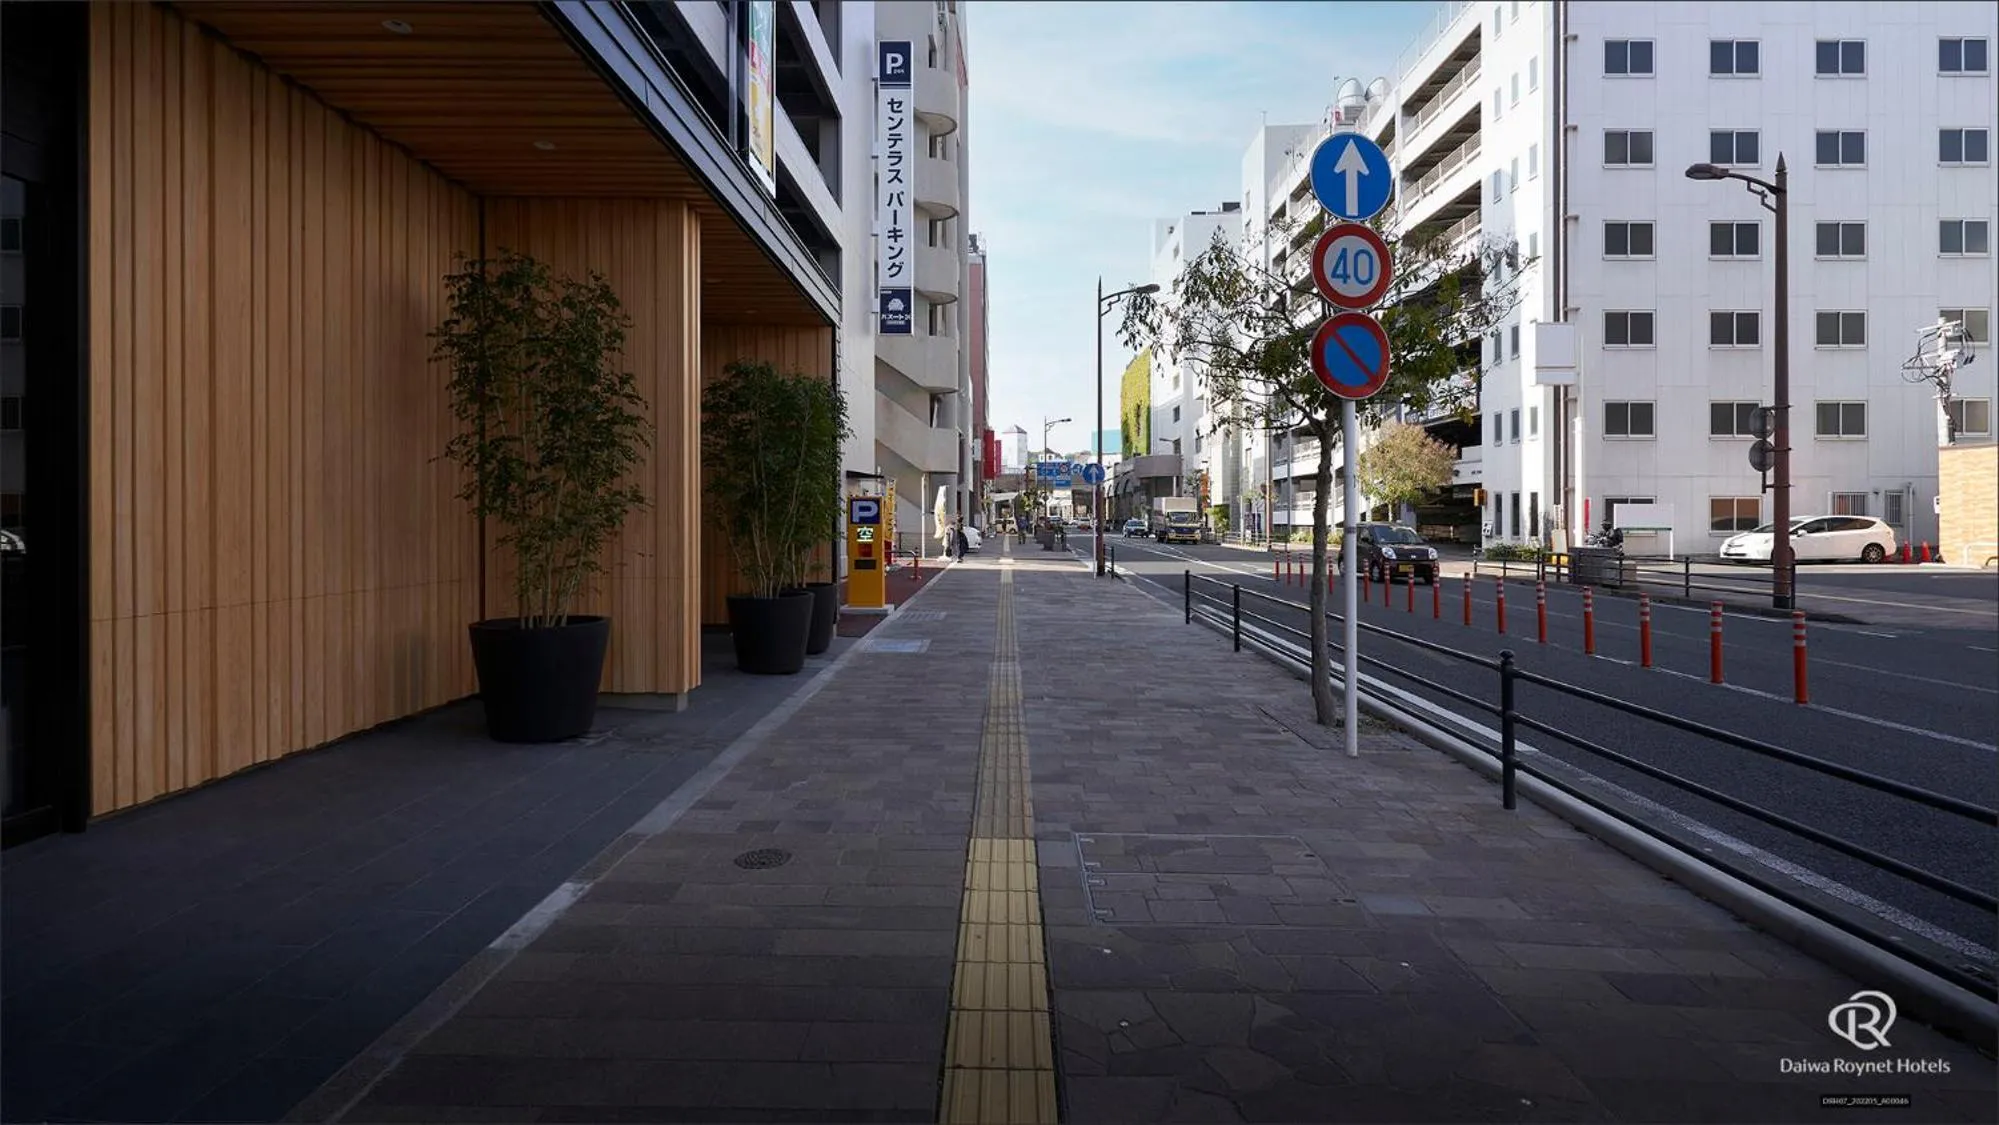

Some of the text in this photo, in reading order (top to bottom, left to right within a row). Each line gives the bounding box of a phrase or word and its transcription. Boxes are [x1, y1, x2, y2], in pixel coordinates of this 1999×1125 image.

[886, 53, 904, 74] P
[887, 98, 904, 279] センテラス パーキング
[1331, 248, 1375, 285] 40
[852, 500, 879, 523] P
